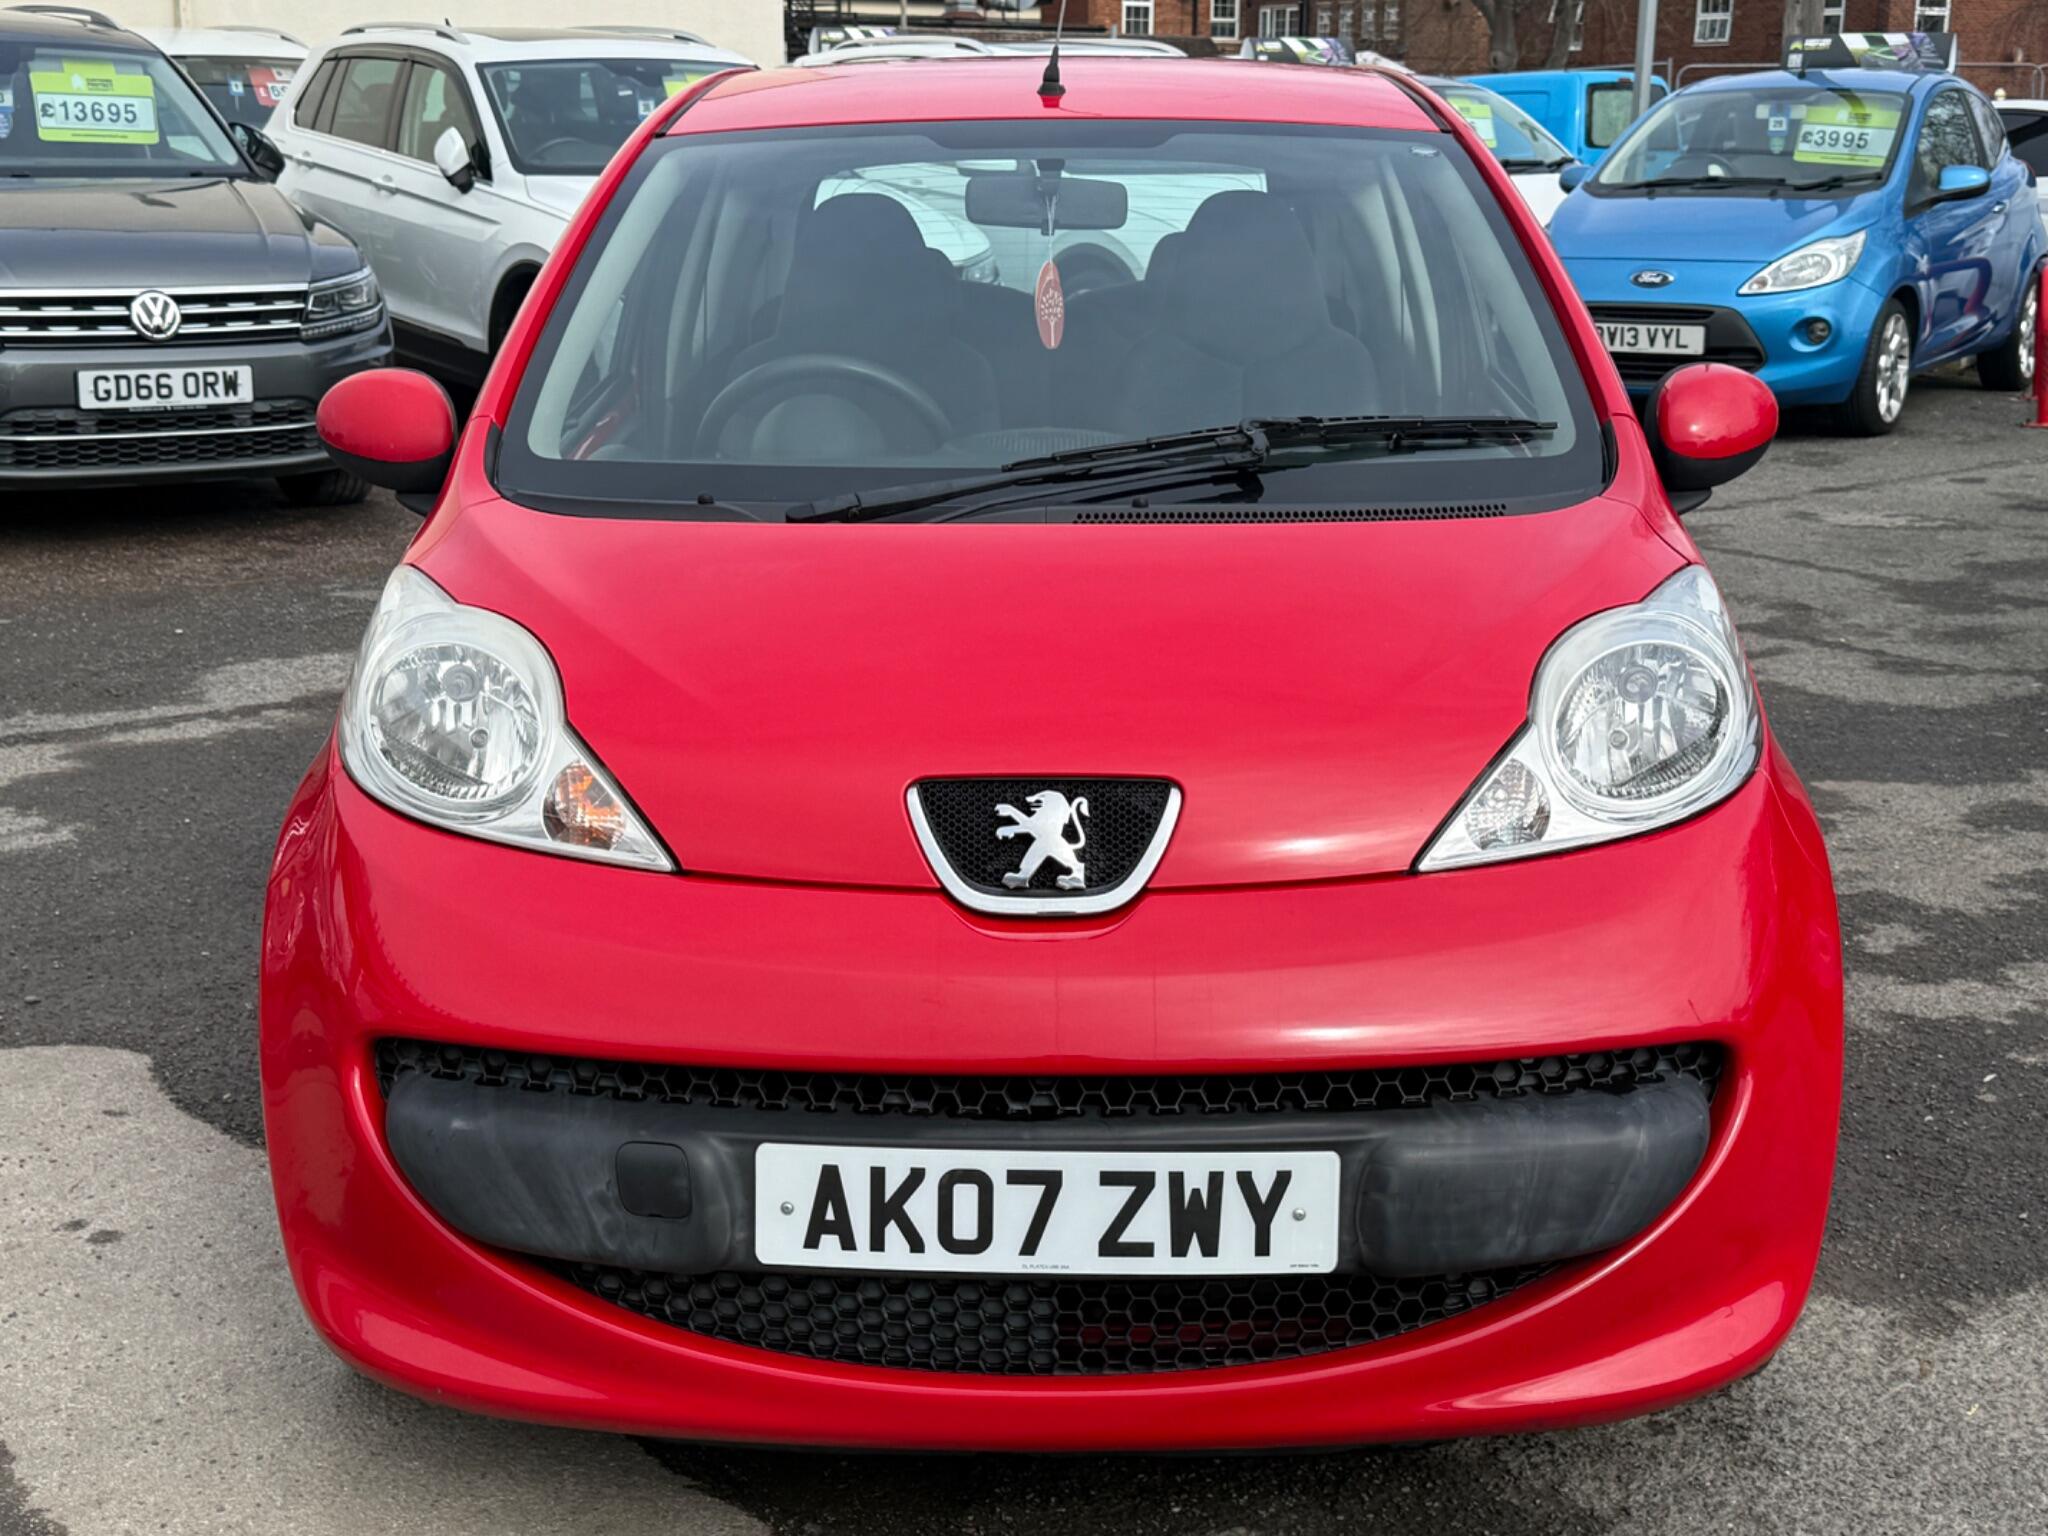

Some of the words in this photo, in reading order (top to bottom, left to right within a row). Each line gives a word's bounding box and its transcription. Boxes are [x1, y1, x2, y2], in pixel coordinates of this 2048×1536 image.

[40, 100, 138, 123] £13695
[1801, 130, 1870, 149] £3995
[1646, 327, 1688, 349] VYL
[93, 374, 173, 402] GD66
[183, 370, 239, 398] ORW
[802, 1164, 1063, 1256] AK07
[1098, 1170, 1293, 1258] ZWY
